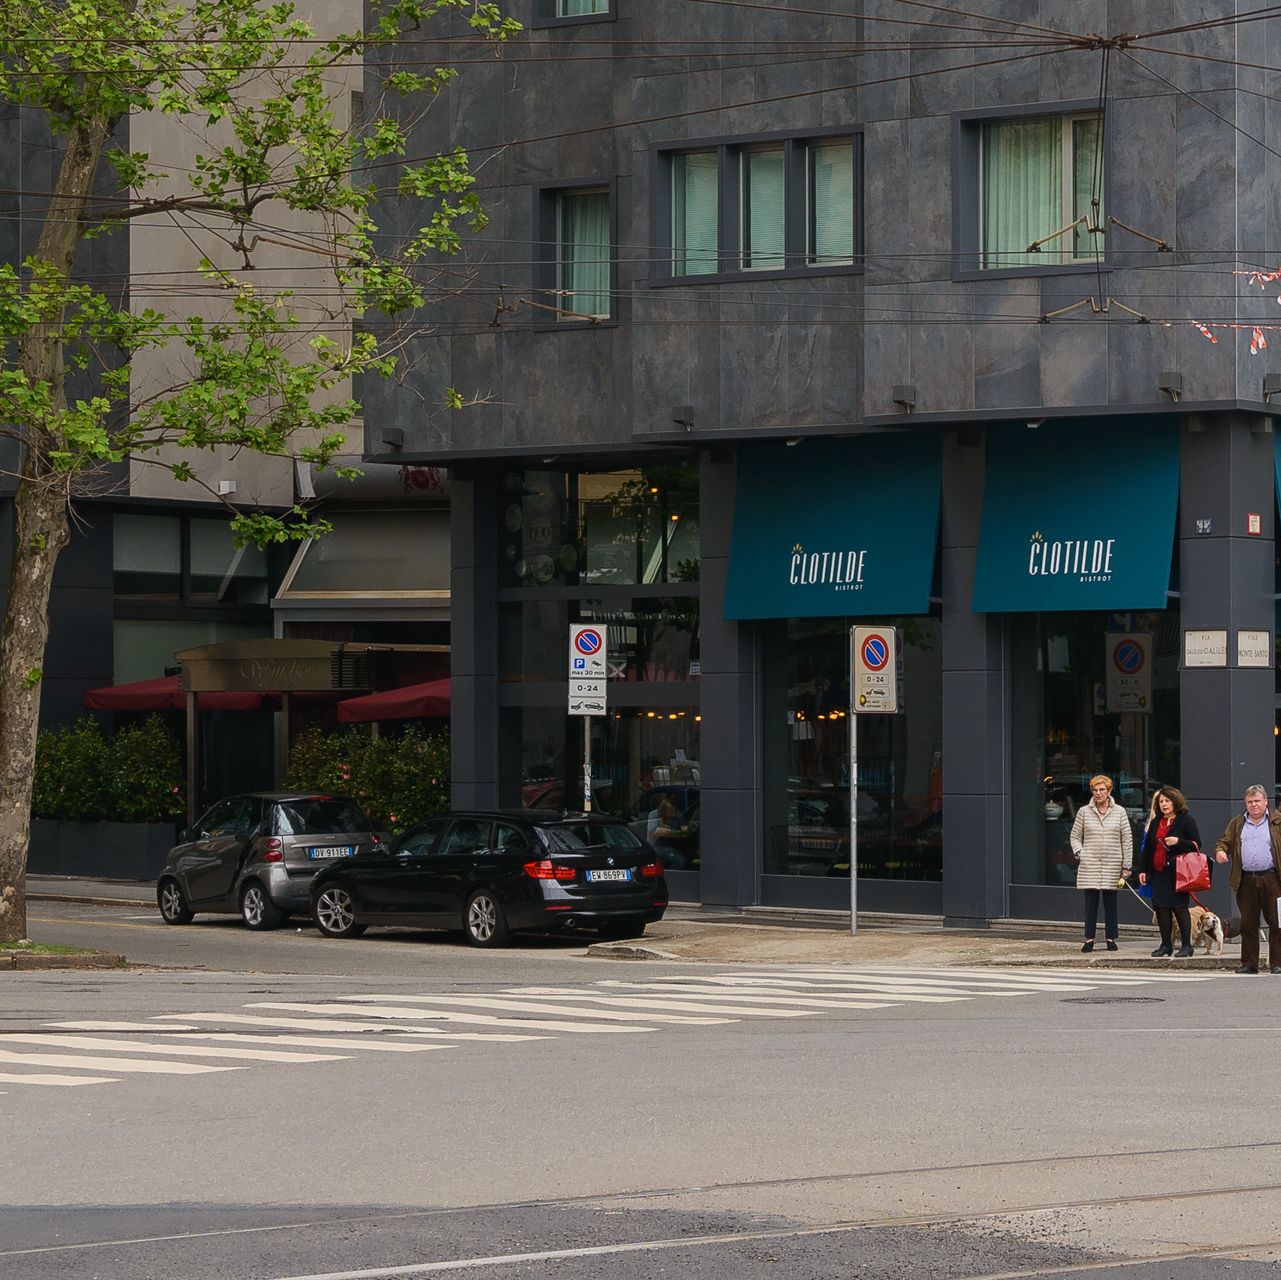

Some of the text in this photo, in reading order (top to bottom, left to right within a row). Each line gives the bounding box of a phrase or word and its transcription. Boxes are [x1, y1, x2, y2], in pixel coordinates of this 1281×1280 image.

[789, 550, 868, 585] CLOTILDE
[1028, 539, 1115, 576] CLOTILDE
[1080, 575, 1112, 583] BISTROT
